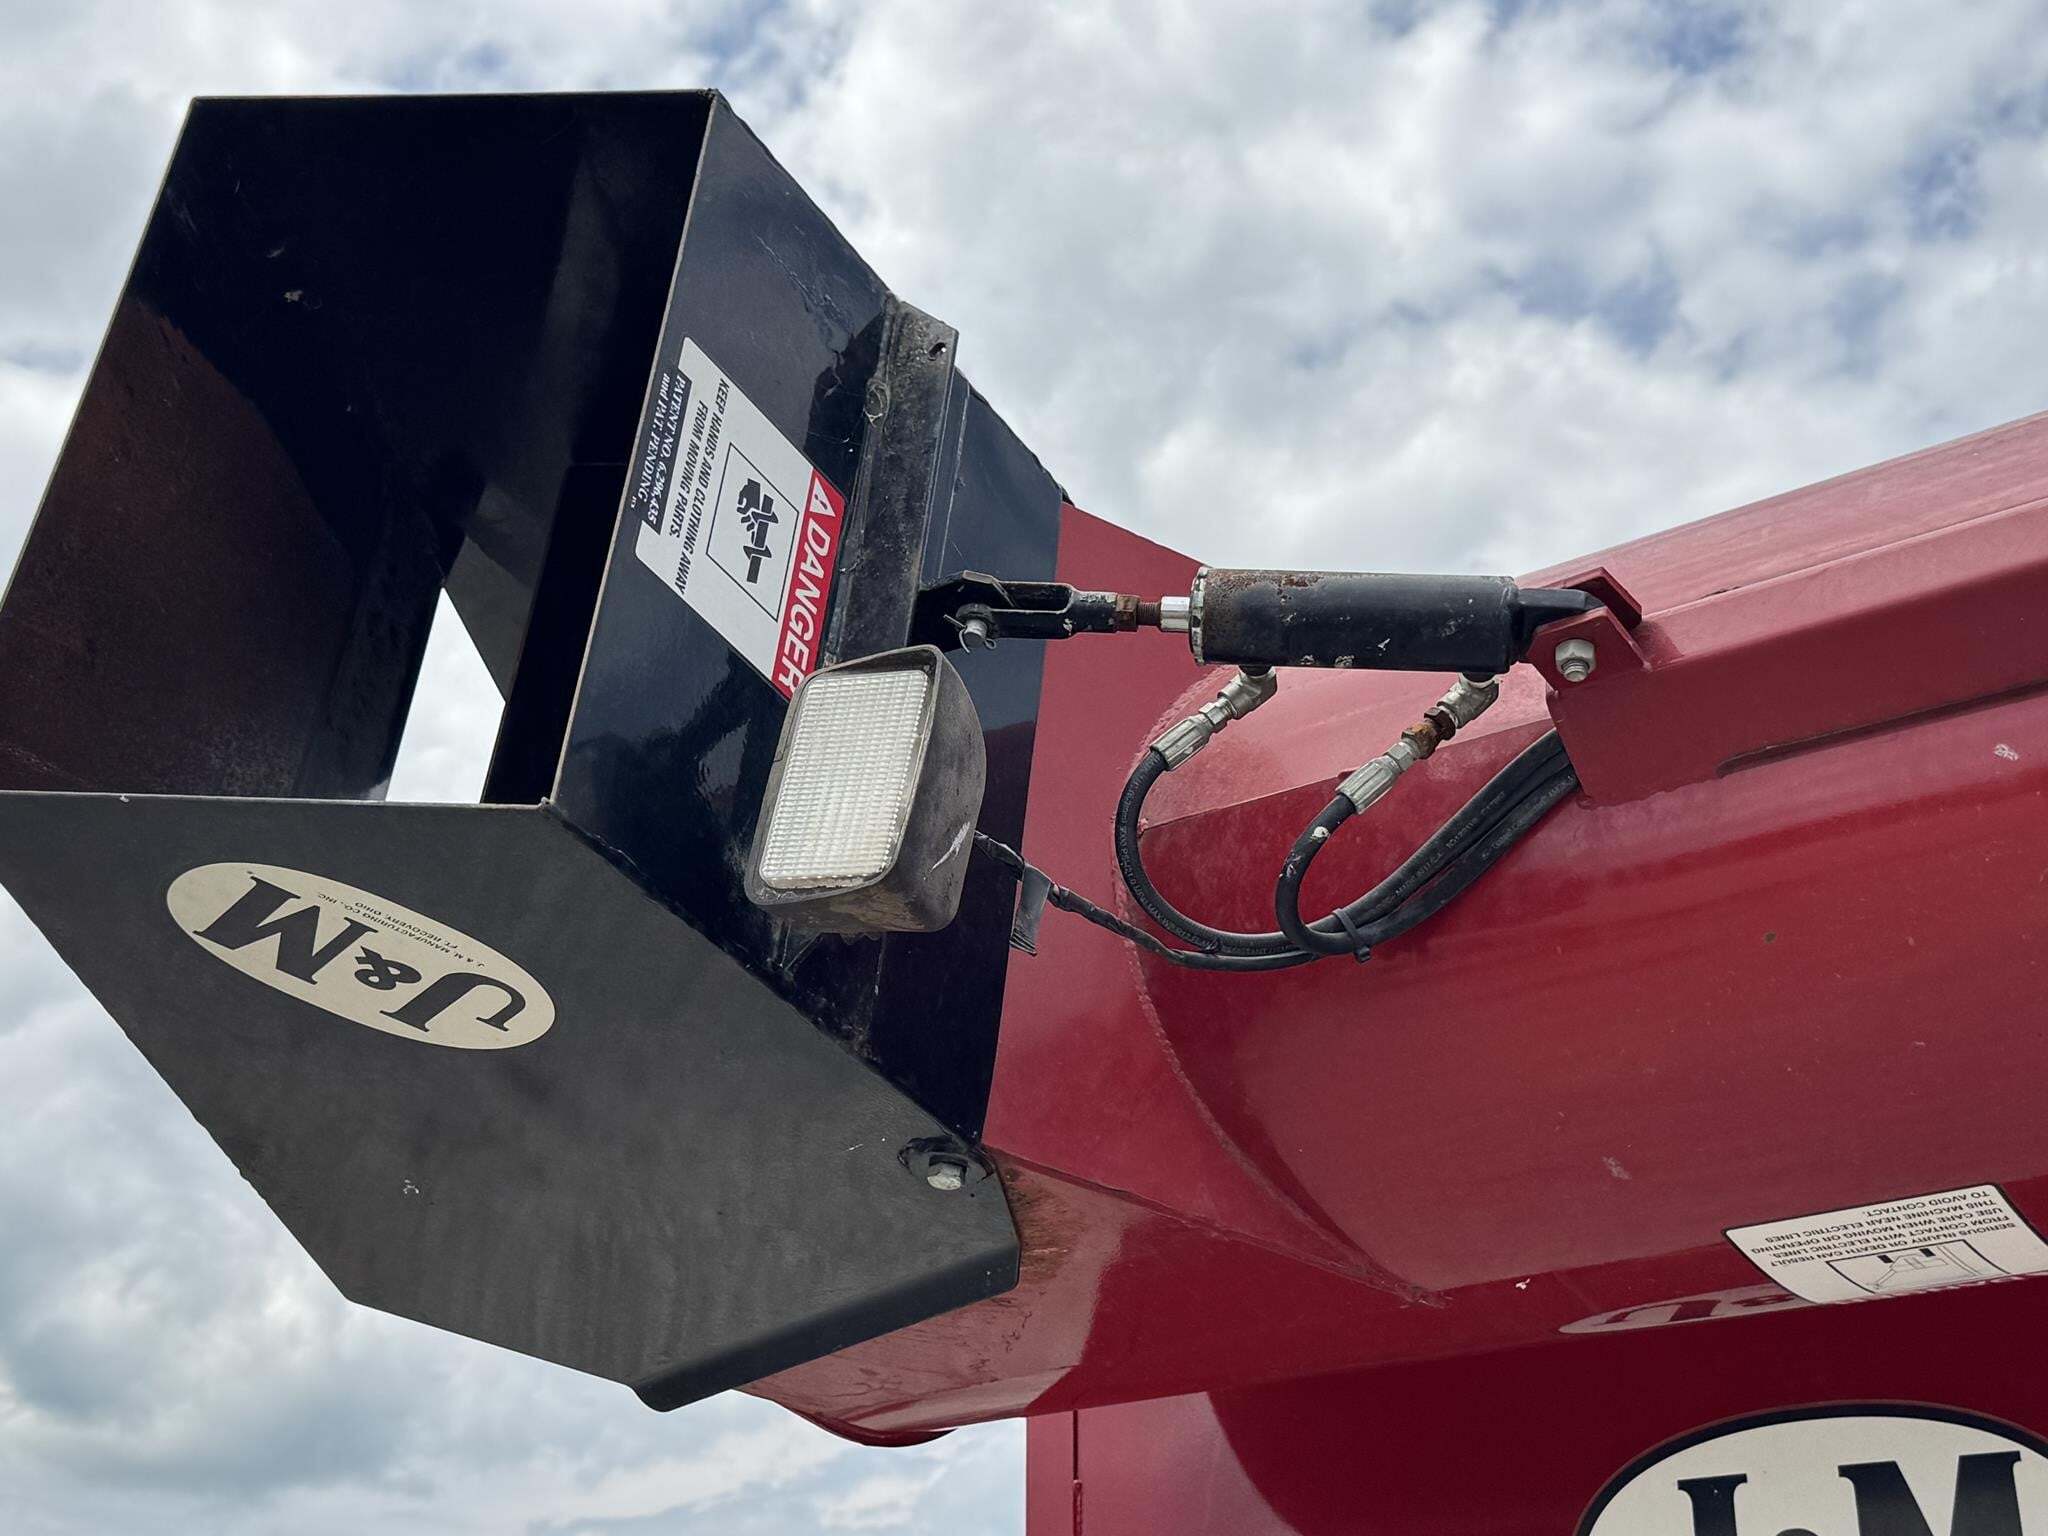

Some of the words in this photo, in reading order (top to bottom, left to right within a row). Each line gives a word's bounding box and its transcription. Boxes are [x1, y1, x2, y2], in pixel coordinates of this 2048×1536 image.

[659, 373, 670, 401] and
[715, 378, 730, 415] KEEP
[667, 375, 686, 435] PATENT
[652, 399, 667, 431] PAT.
[691, 399, 709, 441] FROM
[704, 412, 723, 460] HANDS
[660, 432, 674, 458] NO.
[638, 431, 660, 502] PENDING
[680, 439, 700, 494] MOVING
[698, 457, 713, 489] AND
[669, 491, 689, 539] PARTS.
[683, 487, 706, 555] CLOTHING
[674, 551, 691, 595] AWAY
[778, 517, 831, 694] DANGER
[354, 901, 382, 917] OHIO
[362, 912, 451, 954] MANUFACTURING
[193, 875, 526, 1032] J&M
[1928, 1194, 1968, 1206] AVOID
[1970, 1190, 1991, 1199] TO
[1862, 1202, 1926, 1217] CONTACT.
[1903, 1203, 1964, 1220] MACHINE
[1965, 1199, 1997, 1210] THIS
[1975, 1207, 2003, 1217] USE
[1865, 1216, 1901, 1226] NEAR
[1896, 1219, 1936, 1230] WHEN
[1936, 1212, 1974, 1223] CARE
[1971, 1215, 2010, 1226] FROM
[1802, 1222, 1864, 1237] ELECTRIC
[1842, 1226, 1894, 1239] MOVING
[1909, 1222, 1968, 1237] CONTACT
[1959, 1222, 2016, 1236] SERIOUS
[1764, 1232, 1801, 1243] LINES
[1809, 1239, 1871, 1251] ELECTRIC
[1822, 1234, 1842, 1242] OR
[1872, 1232, 1906, 1243] WITH
[1888, 1240, 1908, 1248] OR
[1912, 1232, 1957, 1244] INJURY
[1750, 1238, 1821, 1254] OPERATING
[1845, 1243, 1887, 1254] DEATH
[1770, 1255, 1815, 1267] RESULT
[1816, 1250, 1843, 1259] CAN
